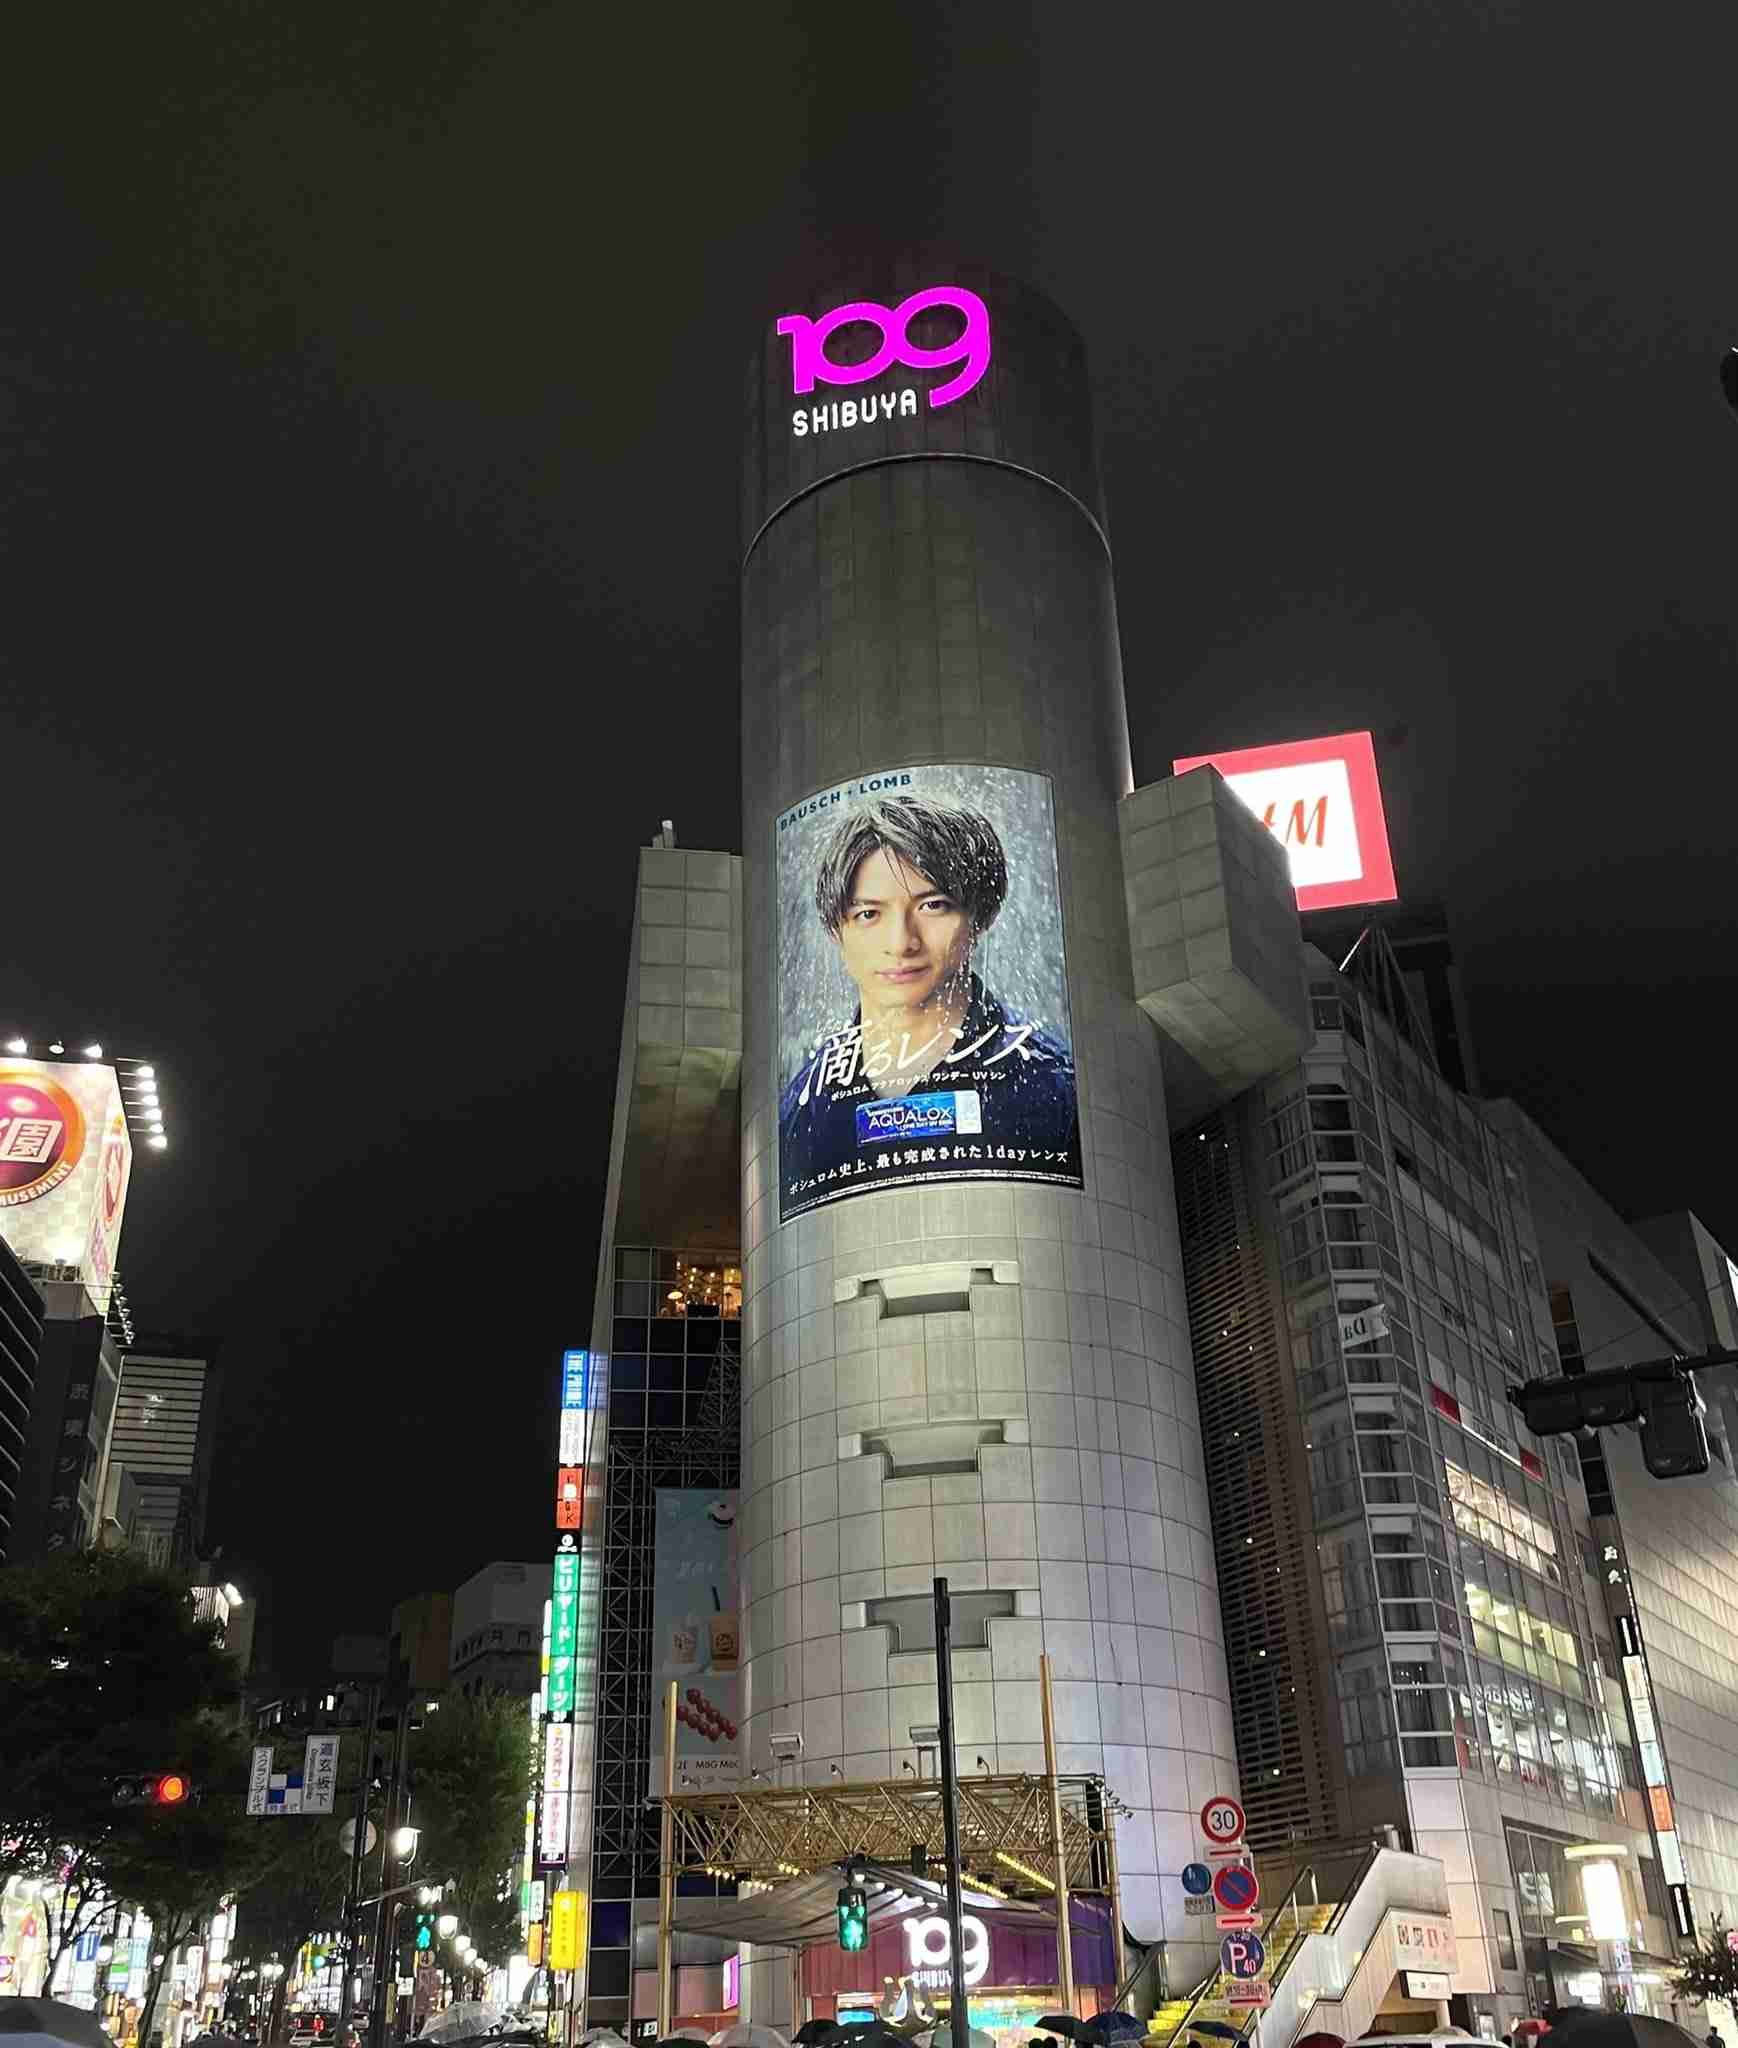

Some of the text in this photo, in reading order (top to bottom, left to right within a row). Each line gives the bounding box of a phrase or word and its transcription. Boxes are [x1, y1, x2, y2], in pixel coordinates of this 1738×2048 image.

[776, 286, 991, 408] 109
[792, 388, 917, 436] SHIBUYA
[780, 791, 841, 831] BAUSCH
[859, 774, 912, 794] LOMB
[798, 1018, 1042, 1106] 滴るレンズ
[972, 1071, 988, 1081] UV
[869, 1107, 952, 1130] AQUALOX
[1210, 1810, 1236, 1831] 30
[902, 1914, 990, 1986] 109
[1229, 1943, 1257, 1975] P 40
